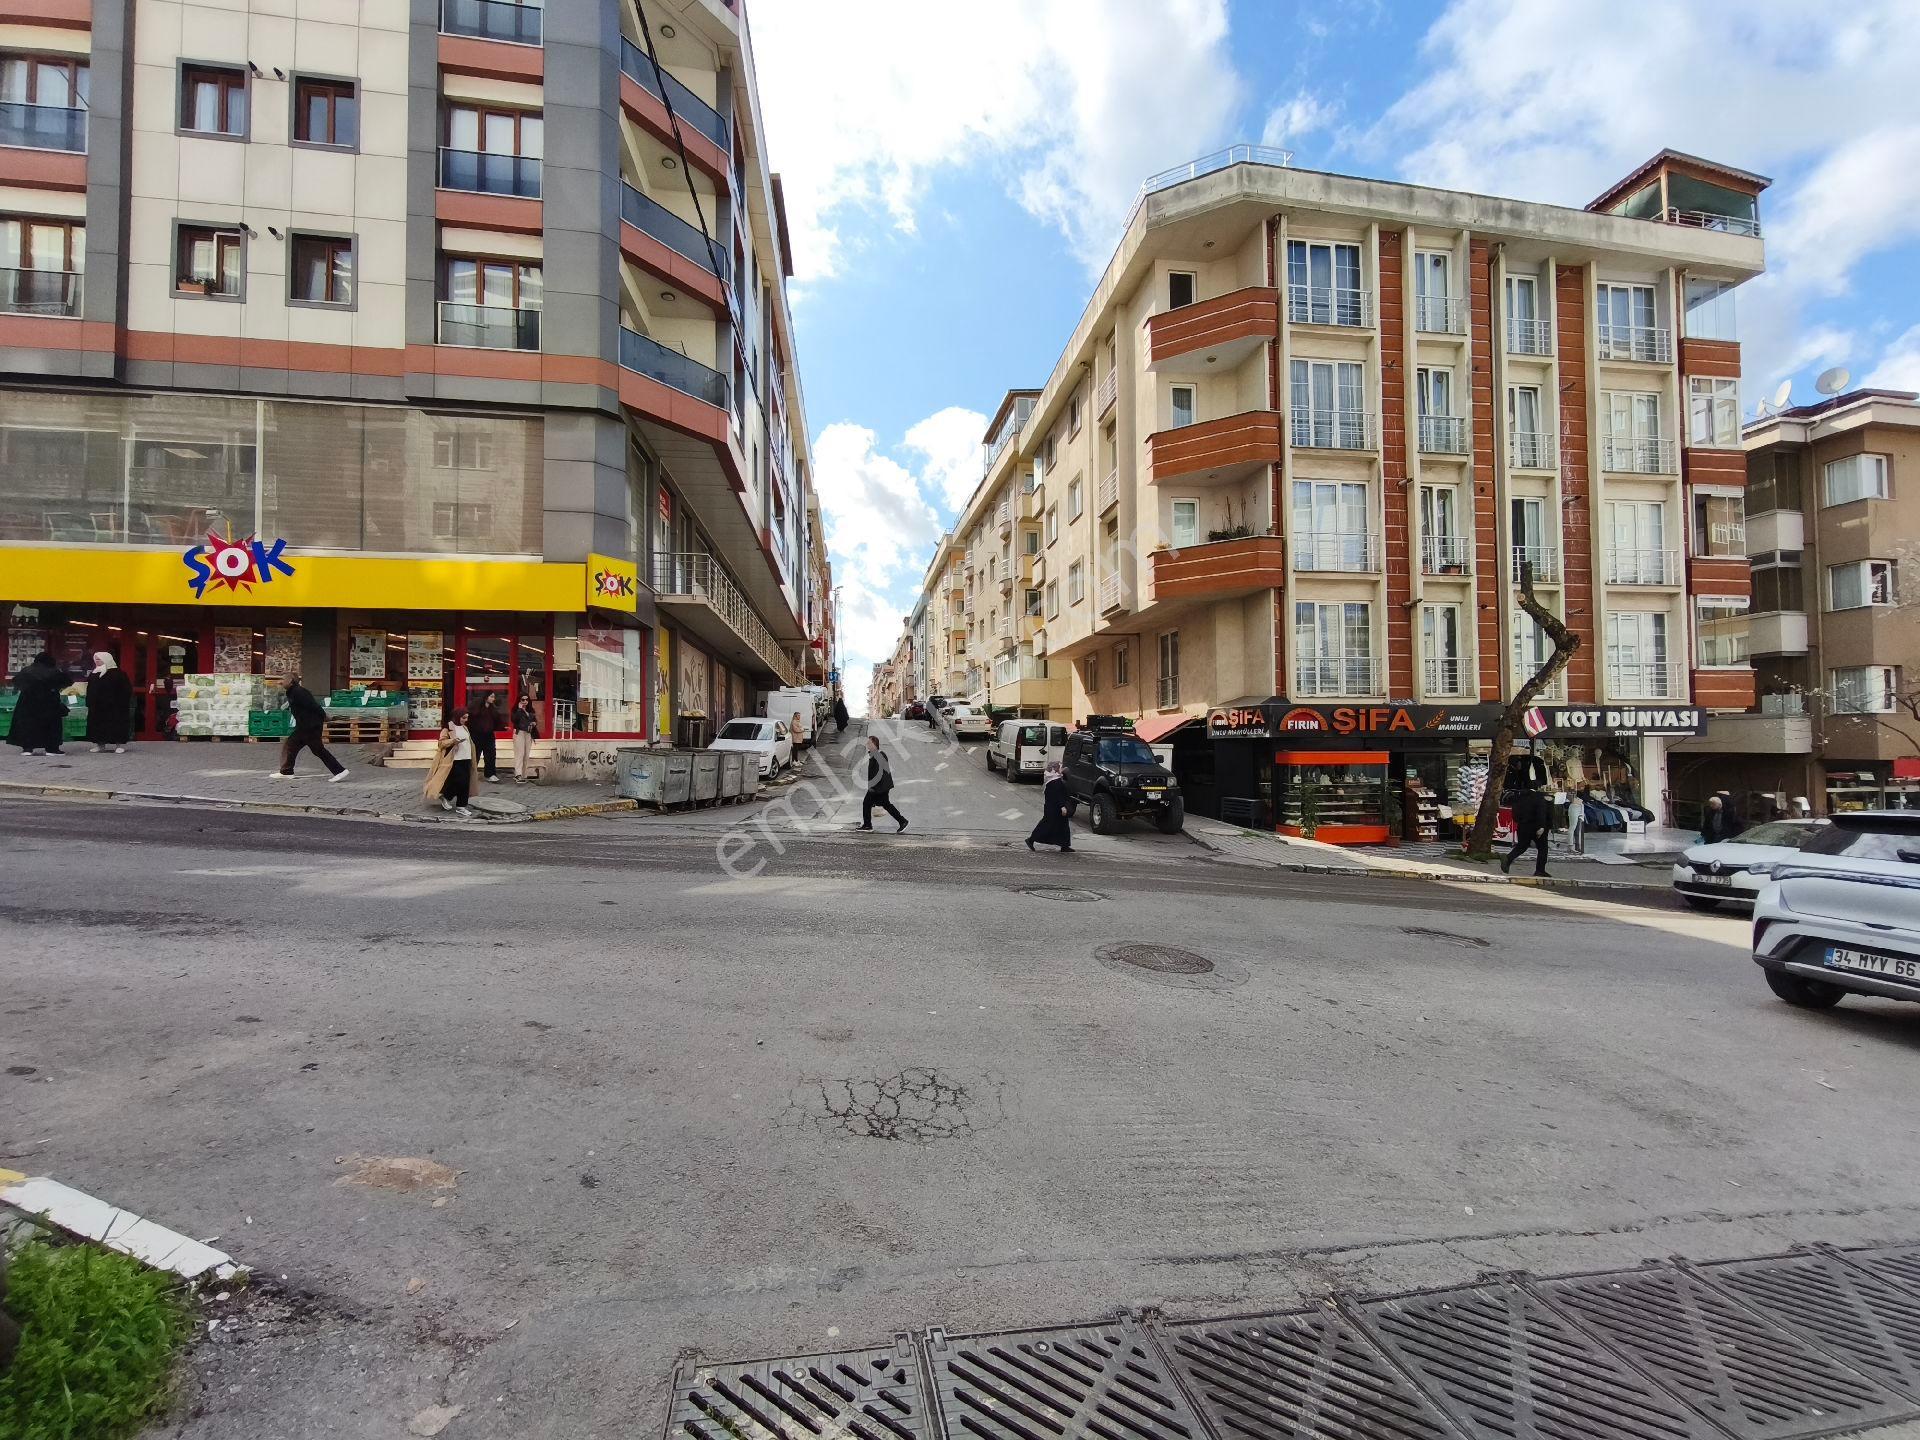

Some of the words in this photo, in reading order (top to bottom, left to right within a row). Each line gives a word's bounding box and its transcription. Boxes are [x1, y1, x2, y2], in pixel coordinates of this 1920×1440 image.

[183, 538, 296, 599] ŞOK
[595, 572, 634, 597] ŞOK
[1287, 720, 1319, 730] FIRIN
[1437, 722, 1481, 732] MAMÜLLERİ
[1554, 711, 1601, 728] KOT
[1606, 707, 1699, 728] DÜNYASI
[1834, 949, 1852, 965] 34
[1859, 953, 1889, 972] MYV
